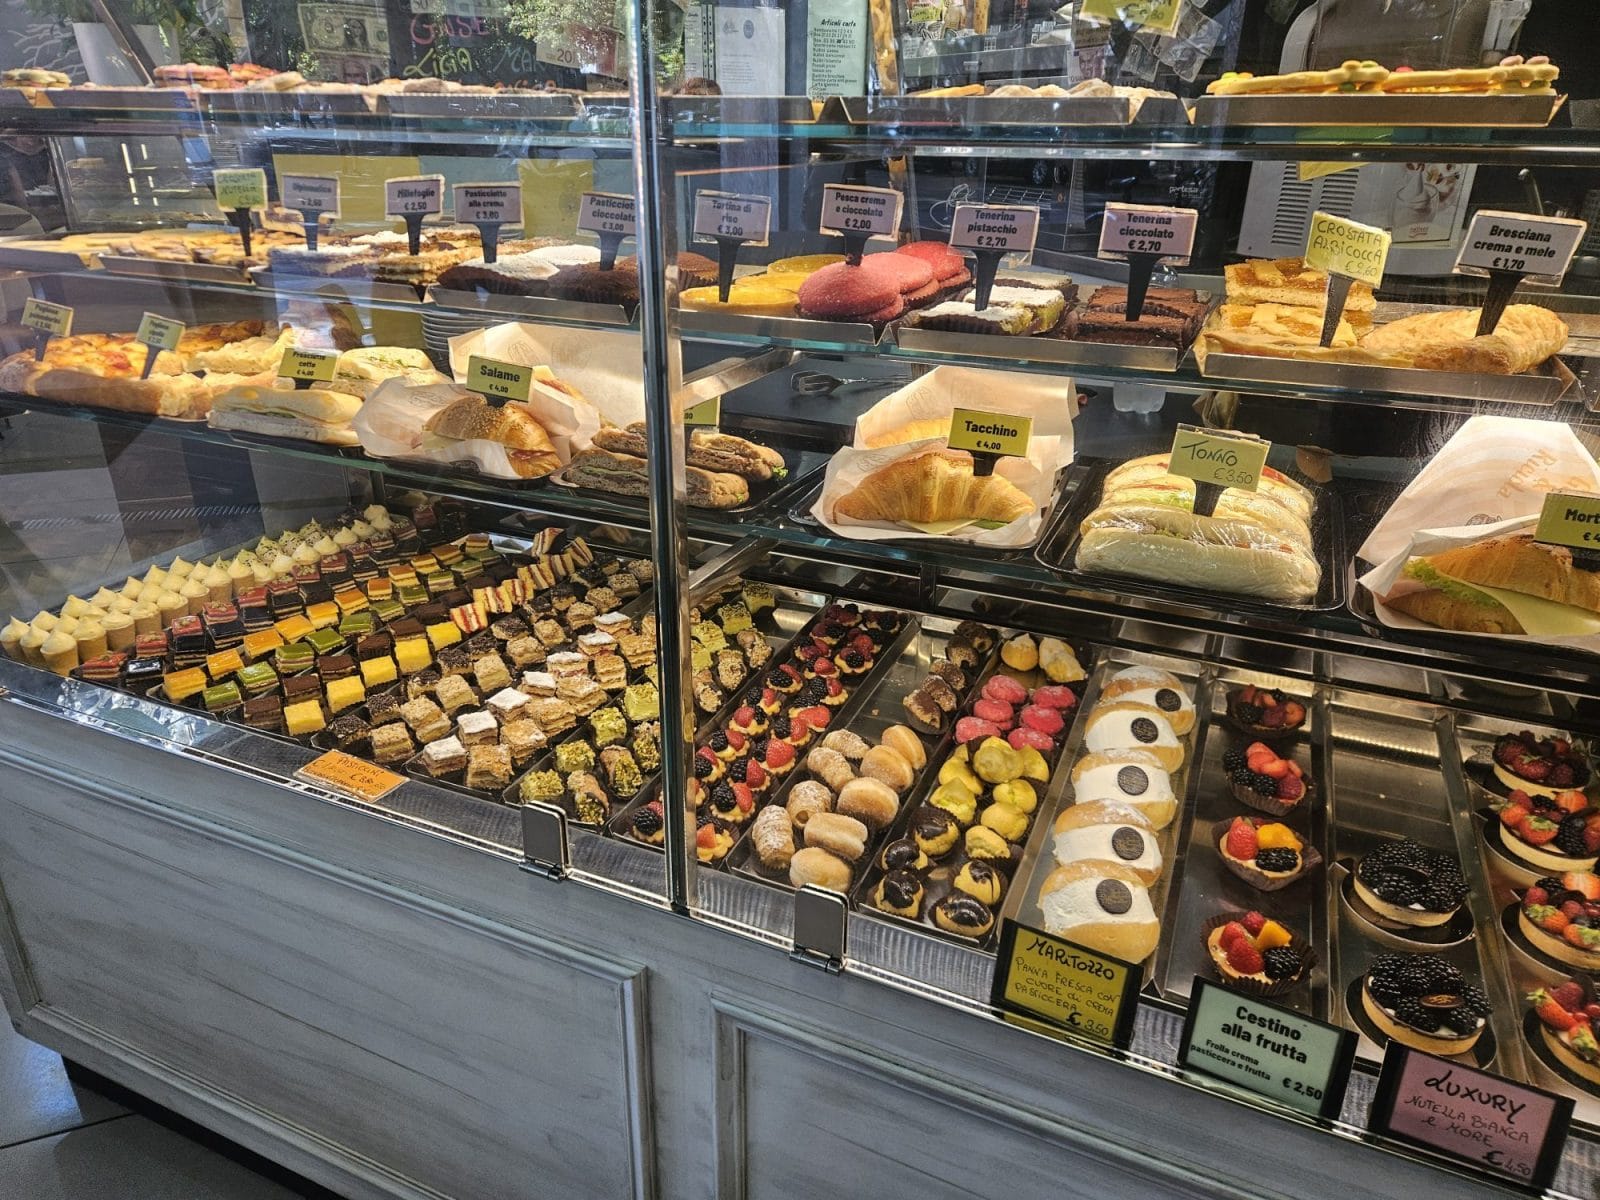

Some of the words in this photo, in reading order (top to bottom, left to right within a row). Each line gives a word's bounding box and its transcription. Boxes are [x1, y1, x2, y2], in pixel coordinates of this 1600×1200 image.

[557, 48, 573, 63] 20
[464, 190, 507, 198] Pasticciotto
[835, 192, 859, 203] Pesca
[860, 196, 886, 206] crema
[468, 200, 481, 208] alla
[590, 198, 635, 211] Pasticciot
[712, 199, 741, 212] Tartina
[743, 203, 752, 213] di
[842, 204, 883, 218] cioccolato
[721, 214, 738, 224] riso
[975, 209, 1016, 222] Tenerina
[1127, 213, 1172, 226] Tenerina
[602, 222, 608, 230] €
[608, 223, 624, 232] 3,00
[717, 225, 723, 233] €
[724, 226, 743, 237] 3,00
[845, 218, 851, 227] €
[852, 219, 871, 230] 2,00
[967, 222, 1017, 235] pistacchio
[1119, 226, 1174, 239] cioccolato
[1317, 220, 1382, 247] CROSTATA
[1490, 224, 1552, 243] Bresciana
[977, 236, 984, 245] €
[985, 237, 1007, 248] 2,70
[1128, 240, 1136, 249] €
[1138, 240, 1161, 252] 2,70
[1473, 239, 1513, 254] crema
[1515, 246, 1523, 254] e
[1525, 245, 1556, 258] mele
[1492, 257, 1501, 267] €
[1502, 258, 1525, 271] 1,70
[480, 365, 520, 382] Salame
[489, 383, 494, 391] €
[494, 384, 509, 393] 4,00
[965, 420, 1018, 437] Tacchino
[976, 440, 982, 448] €
[983, 441, 1001, 451] 4,00
[1181, 440, 1238, 467] TONNO
[1565, 508, 1600, 525] Mort
[1583, 531, 1591, 541] €
[1016, 956, 1048, 979] PANNA
[1055, 972, 1093, 995] FRESCA
[1025, 977, 1062, 996] CUORE
[1086, 999, 1114, 1017] CREMA
[1236, 1006, 1302, 1041] Cestino
[1221, 1022, 1252, 1043] alla
[1255, 1033, 1307, 1065] frutta
[1206, 1039, 1230, 1056] Frolla
[1231, 1049, 1260, 1067] crema
[1191, 1043, 1237, 1067] pasticcera
[1237, 1061, 1244, 1070] e
[1244, 1063, 1272, 1081] frutta
[1282, 1076, 1292, 1089] €
[1293, 1080, 1323, 1101] 2,50
[1424, 1070, 1526, 1124] LUXURY
[1404, 1095, 1466, 1122] NUTELLA
[1446, 1122, 1494, 1147] MORE
